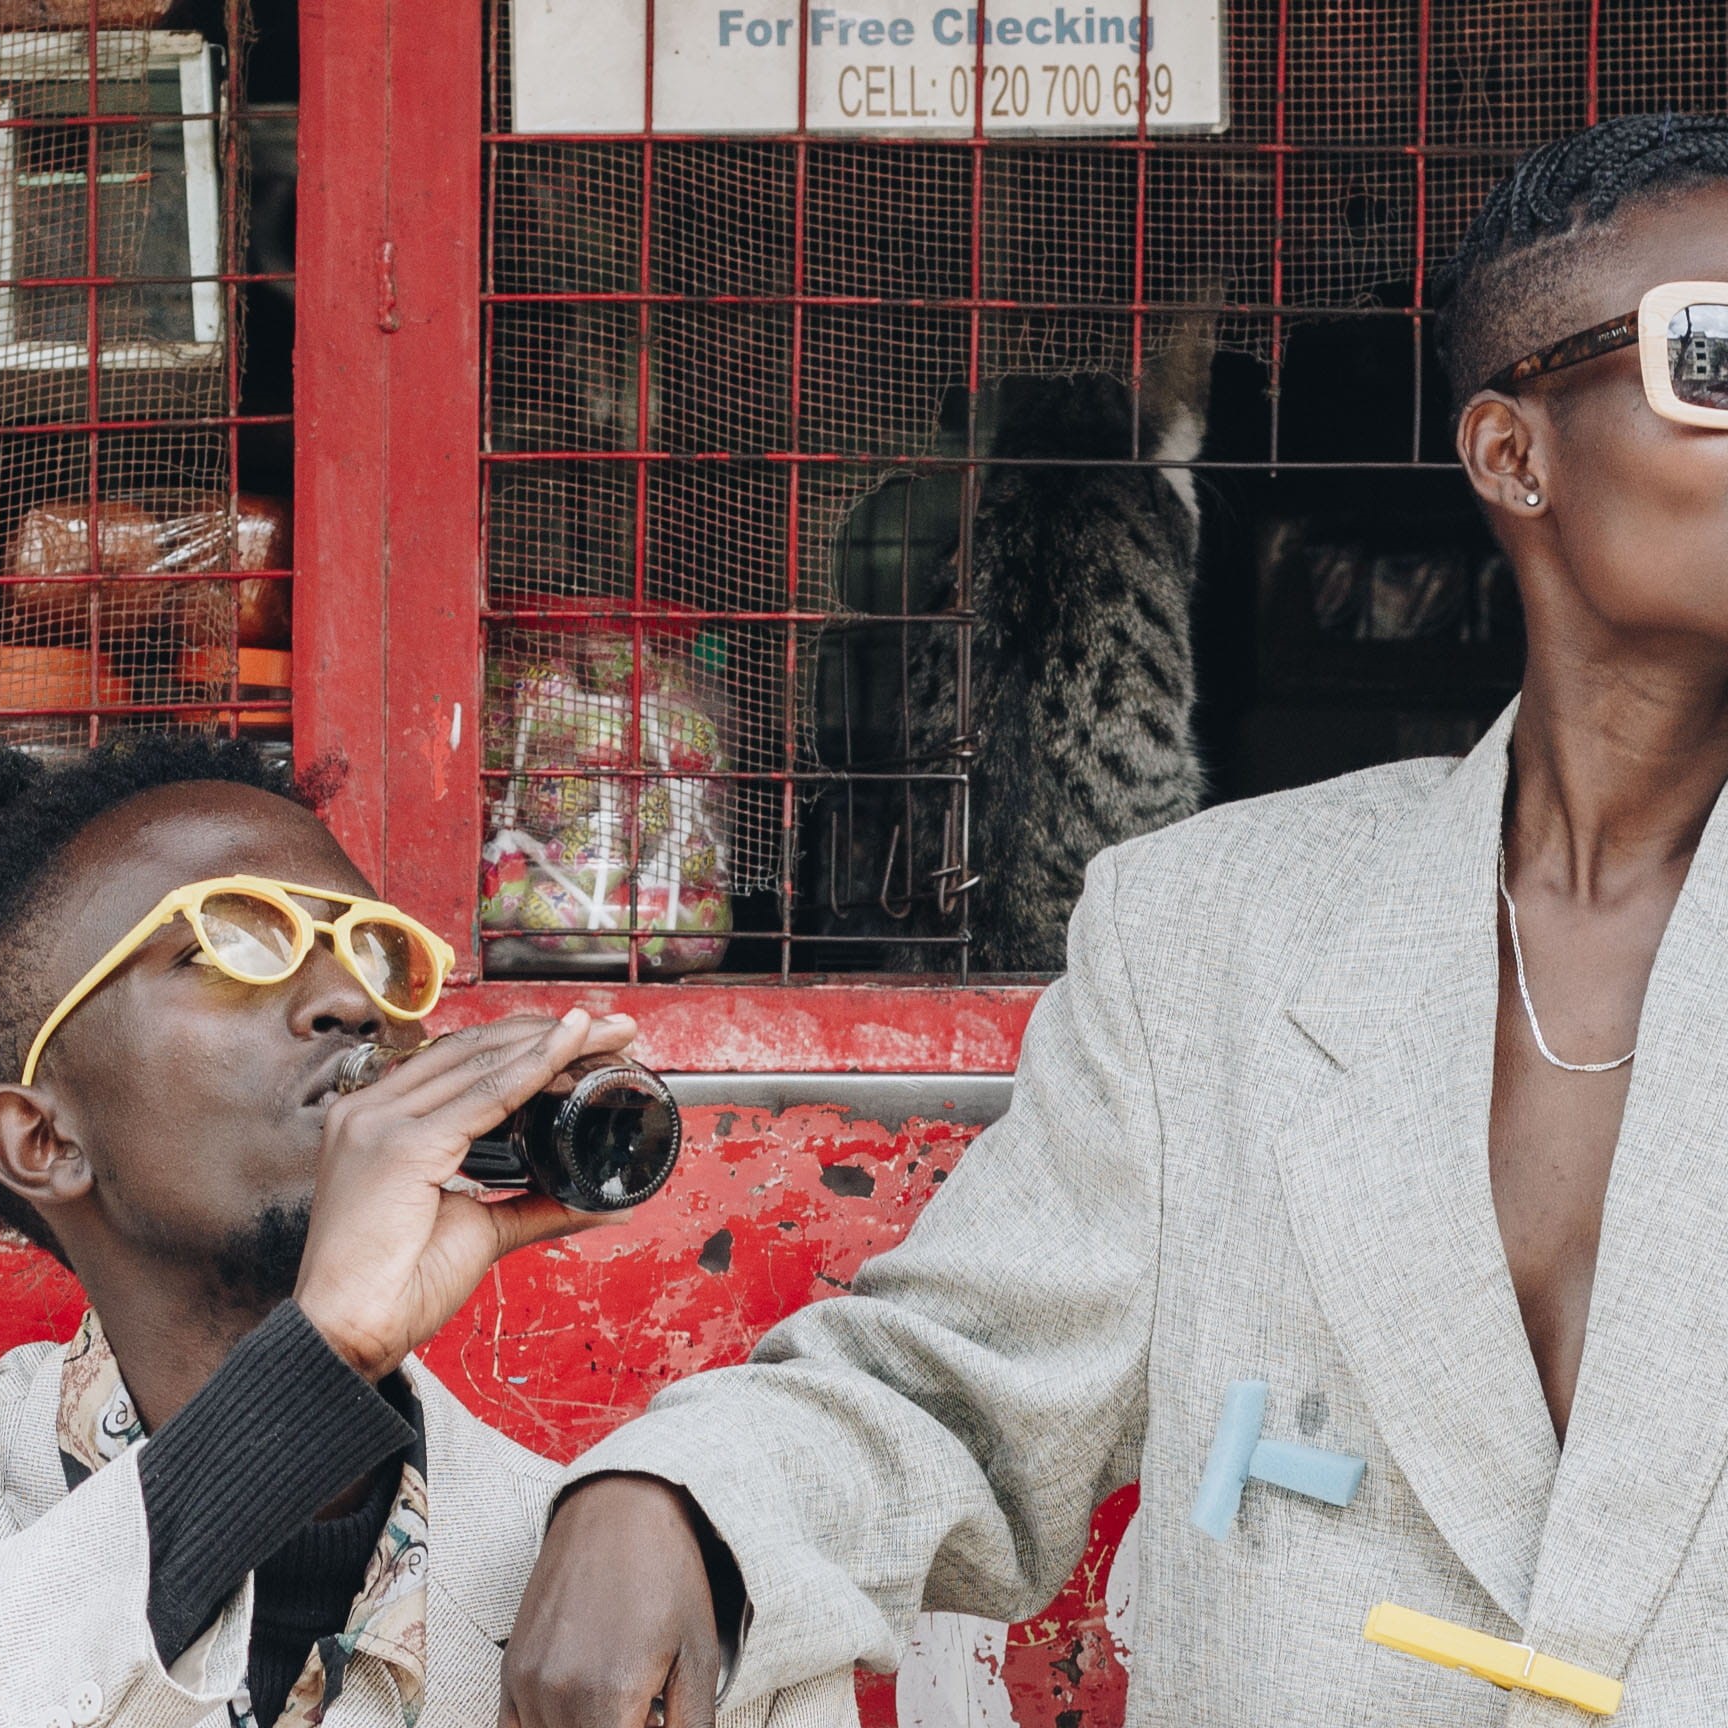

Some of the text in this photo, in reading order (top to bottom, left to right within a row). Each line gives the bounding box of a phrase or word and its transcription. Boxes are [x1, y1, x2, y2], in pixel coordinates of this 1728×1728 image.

[718, 6, 1154, 53] For Free Checking
[838, 65, 937, 118] CELL:
[1042, 65, 1100, 116] 700
[1113, 63, 1173, 116] 639
